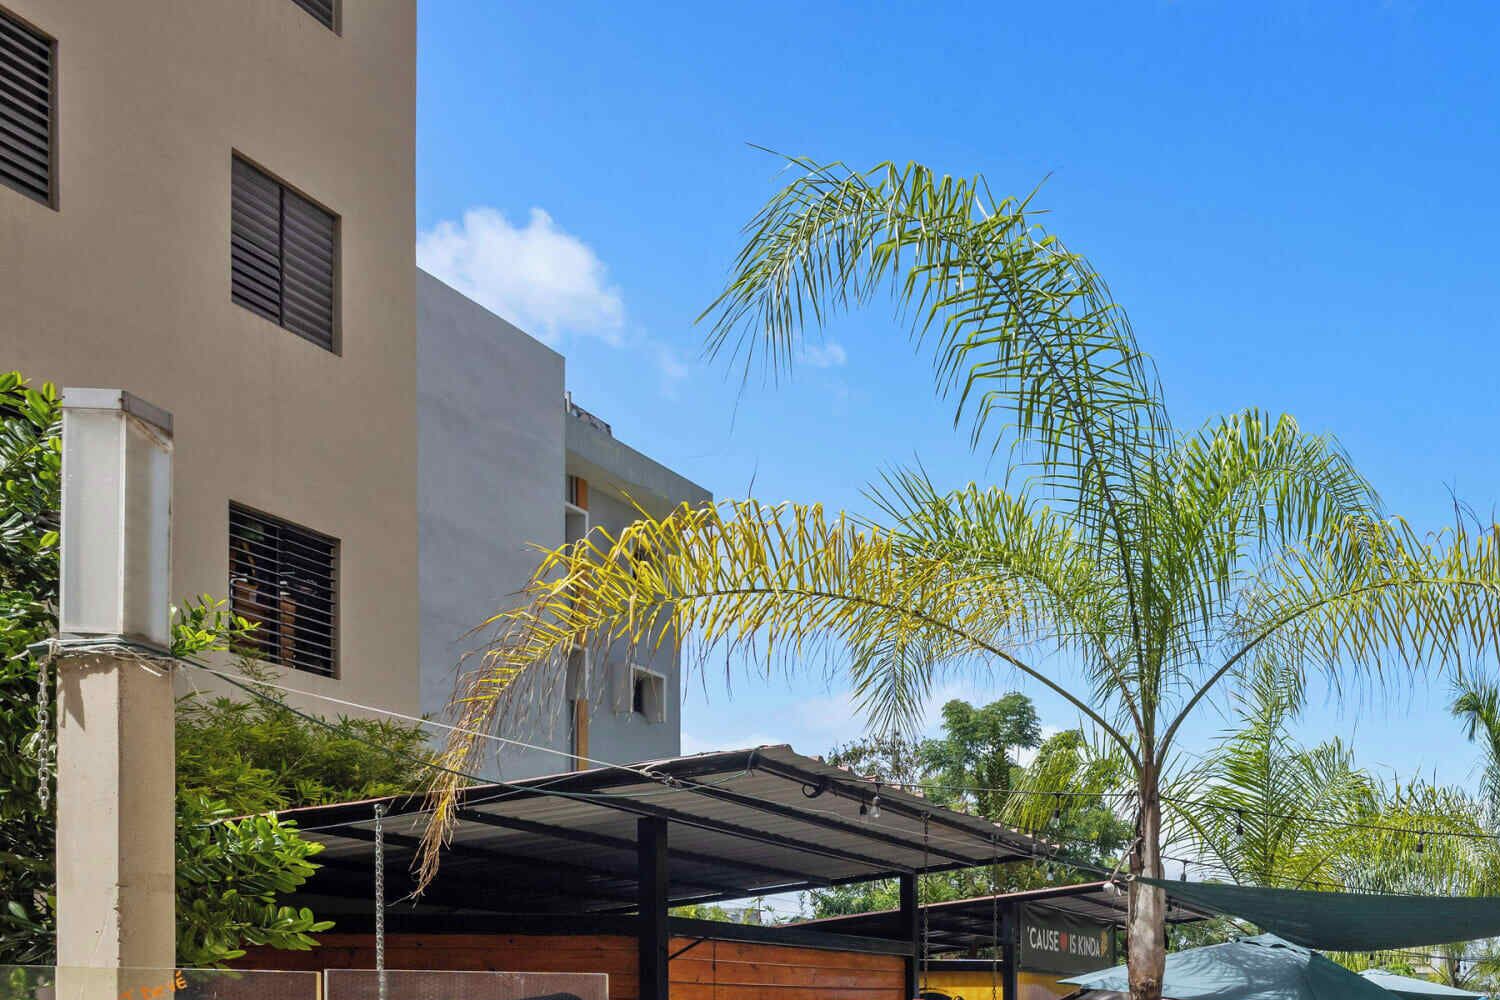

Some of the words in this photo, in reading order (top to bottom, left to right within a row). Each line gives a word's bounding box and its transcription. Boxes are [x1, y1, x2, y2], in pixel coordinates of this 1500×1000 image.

[1027, 926, 1060, 952] 'CAUSE
[1069, 934, 1077, 954] IS
[1078, 936, 1101, 958] KINDA
